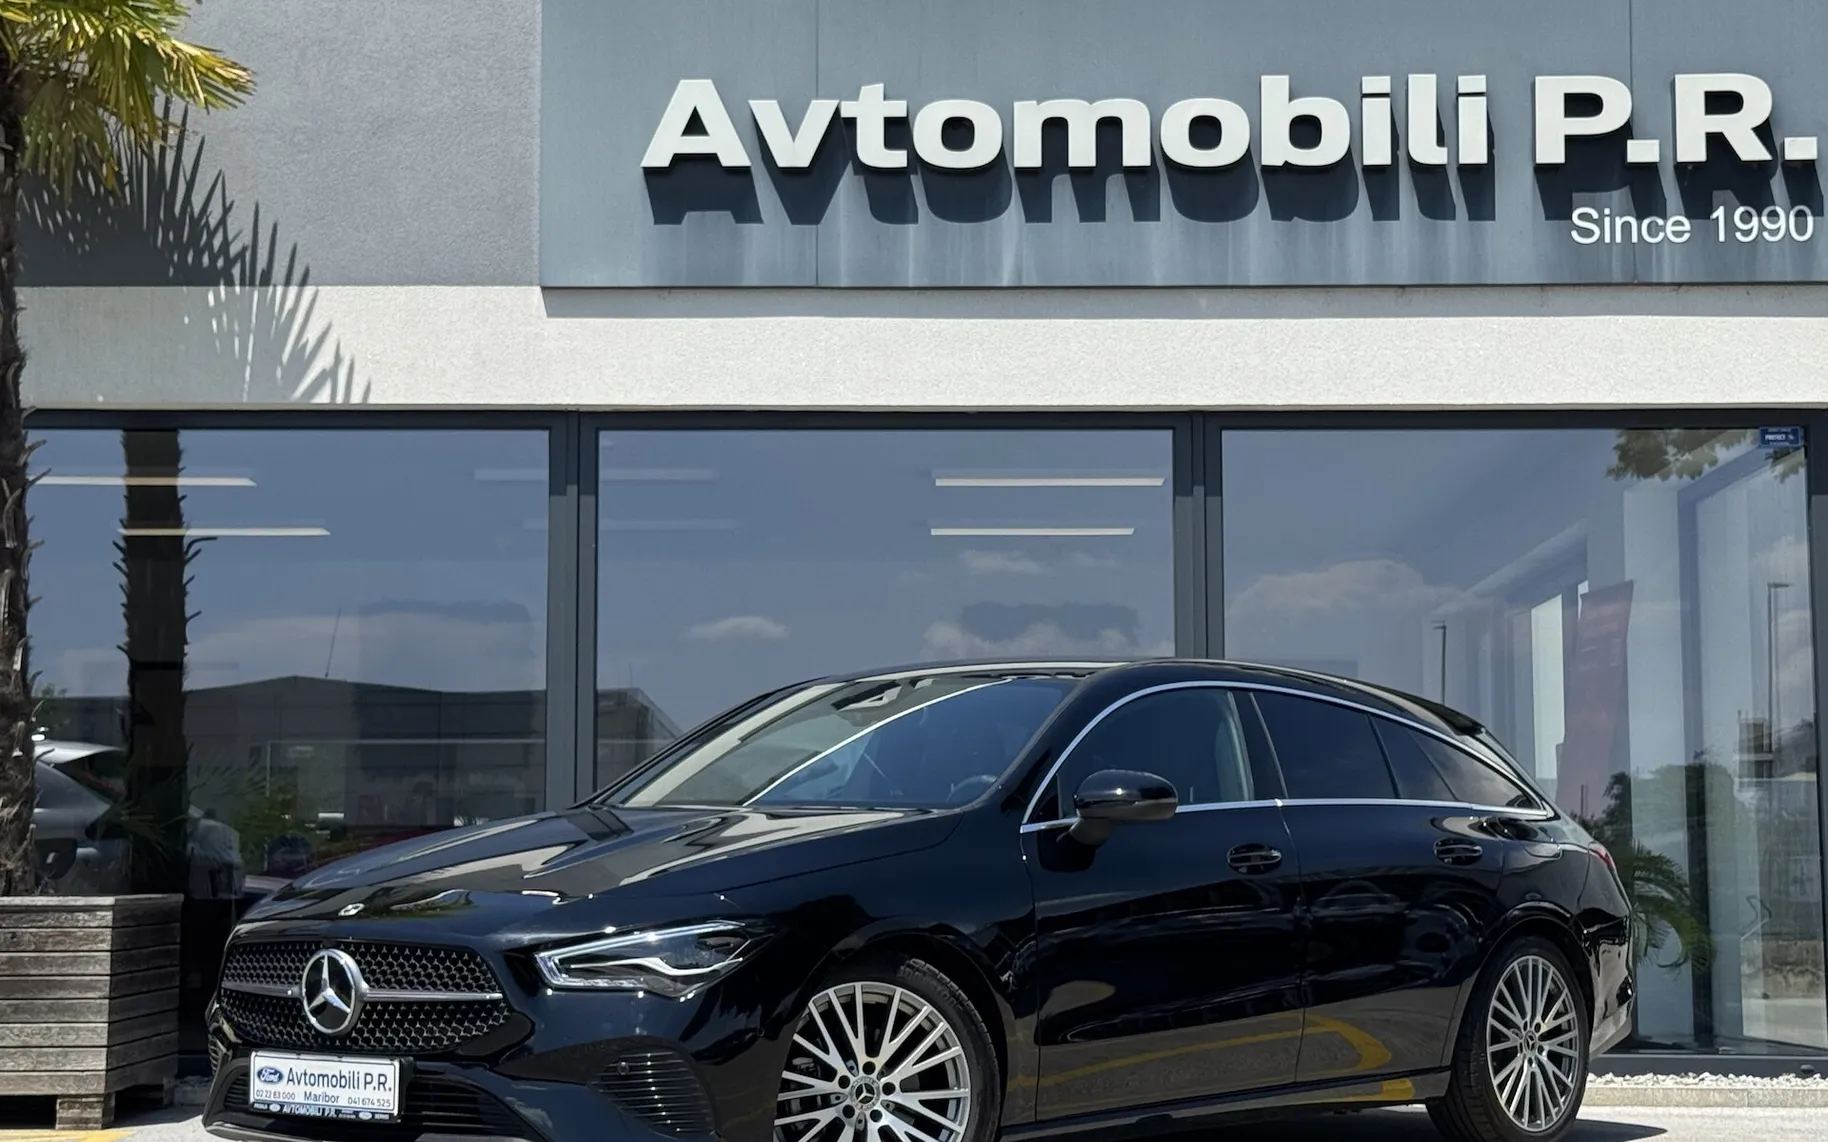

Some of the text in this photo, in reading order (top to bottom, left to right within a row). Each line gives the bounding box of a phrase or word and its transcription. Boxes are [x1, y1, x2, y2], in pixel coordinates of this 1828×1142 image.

[640, 73, 1818, 168] Avtomobili P.R.
[1571, 205, 1814, 244] Since 1990
[260, 1067, 280, 1082] Ford
[286, 1067, 392, 1092] Avtomobili P.R.
[256, 1089, 264, 1098] 02
[304, 1090, 340, 1104] Maribor
[347, 1096, 391, 1108] 041 674 525
[282, 1103, 322, 1116] AVTOMOBILI
